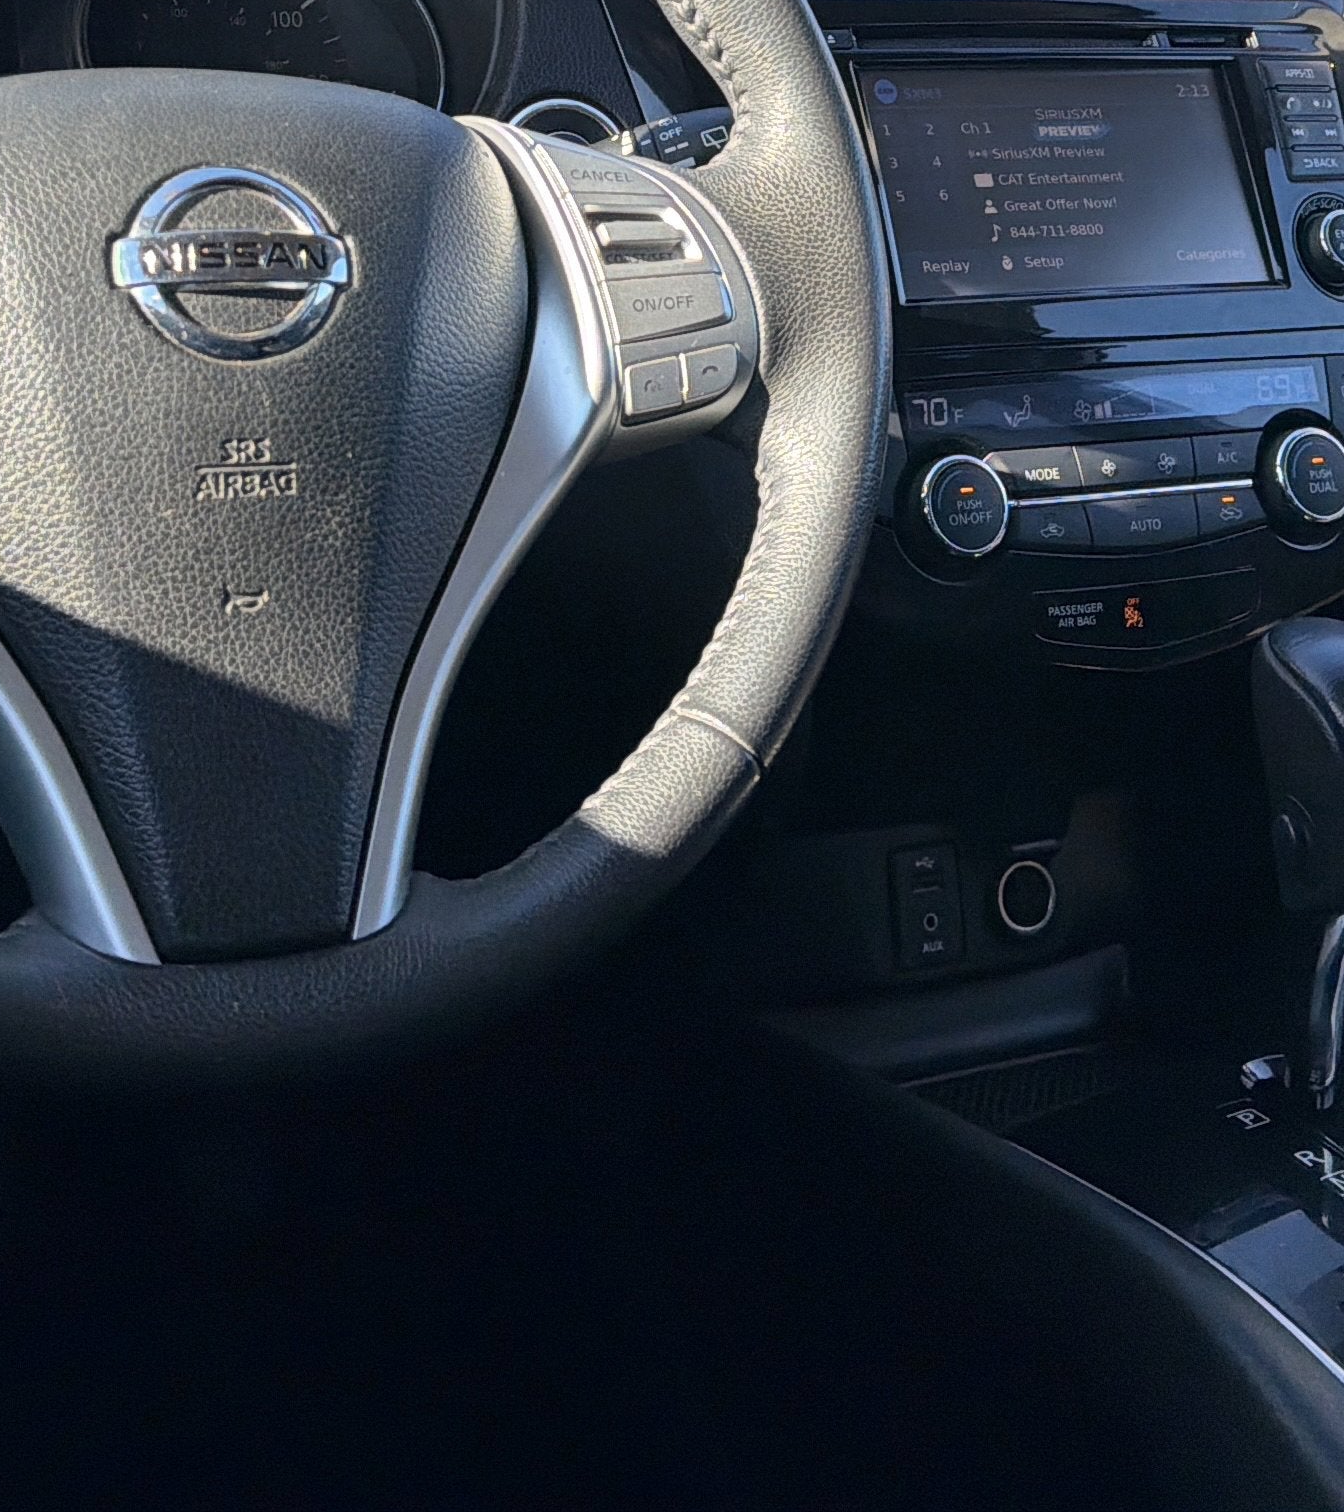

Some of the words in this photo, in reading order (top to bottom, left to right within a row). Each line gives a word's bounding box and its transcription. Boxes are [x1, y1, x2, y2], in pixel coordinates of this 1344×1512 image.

[271, 10, 303, 29] 100
[1175, 83, 1211, 98] 2:13
[659, 126, 684, 142] OFF
[883, 124, 891, 136] 1
[925, 123, 935, 136] 2
[960, 122, 980, 135] Ch
[983, 122, 992, 134] 1
[992, 146, 1050, 160] SiriusXM
[1053, 145, 1105, 159] Preview
[889, 157, 899, 169] 3
[932, 155, 942, 168] 4
[1314, 157, 1338, 168] BACK
[570, 168, 634, 183] CANCEL
[998, 172, 1024, 186] CAT
[1028, 171, 1125, 185] Entertainment
[896, 190, 905, 202] 5
[939, 189, 949, 201] 6
[1004, 200, 1042, 212] Great
[1045, 198, 1079, 210] Offer
[1083, 197, 1118, 209] Now!
[1009, 223, 1105, 238] 844-711-8800
[143, 241, 327, 273] NISSAN
[1176, 247, 1246, 263] Categories
[922, 260, 971, 276] Replay
[1023, 256, 1064, 270] Setup
[632, 294, 695, 313] ON/OFF
[912, 397, 948, 426] 70
[221, 439, 273, 464] SRS
[1218, 451, 1239, 464] A/C
[1024, 467, 1061, 481] MODE
[1309, 469, 1333, 480] PUSH
[196, 468, 297, 501] AIRBAG
[1309, 481, 1339, 494] DUAL
[957, 499, 983, 510] PUSH
[948, 510, 993, 526] ON-OFF
[1130, 518, 1162, 532] AUTO
[1126, 597, 1141, 606] OFF
[1048, 602, 1104, 617] PASSENGER
[1058, 617, 1075, 628] AIR
[1077, 615, 1097, 627] BAG
[922, 940, 944, 953] AUX
[1293, 1149, 1325, 1168] R
